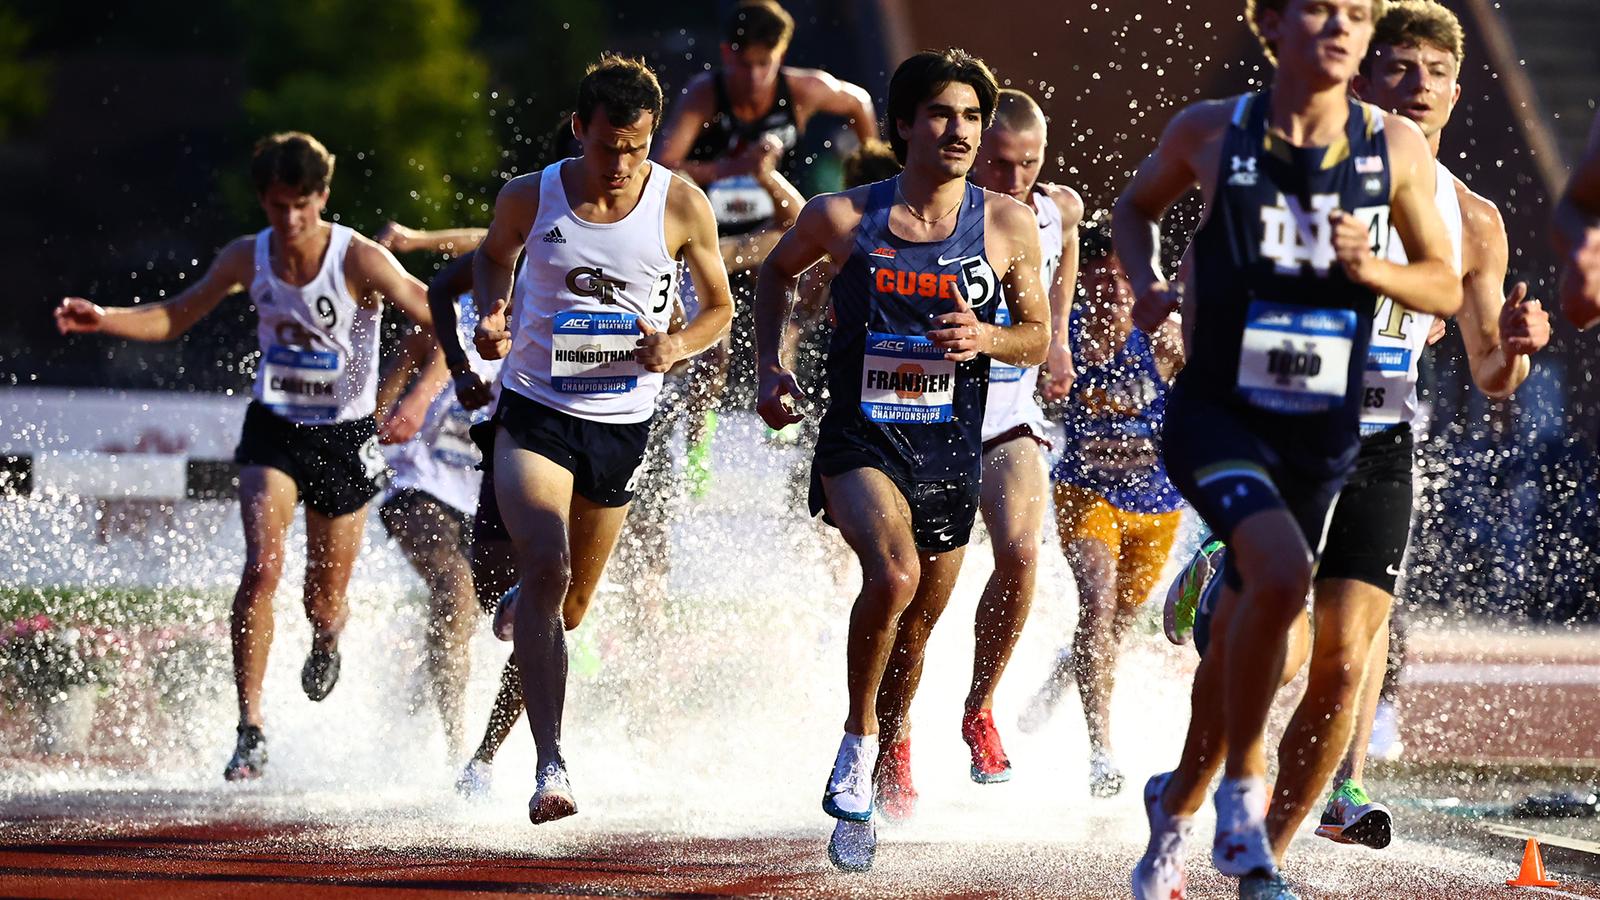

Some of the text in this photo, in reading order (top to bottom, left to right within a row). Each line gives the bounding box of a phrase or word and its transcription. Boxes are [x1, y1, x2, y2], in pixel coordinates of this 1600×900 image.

[543, 236, 566, 244] adidas
[869, 247, 897, 259] ACC
[962, 259, 989, 306] 5
[653, 273, 671, 313] 3
[316, 296, 337, 328] 9
[560, 318, 591, 329] ACC
[872, 340, 905, 352] ACC
[555, 349, 636, 363] HIGINBOTHAM
[561, 382, 627, 392] CHAMPIONSHIPS
[871, 409, 941, 421] CHAMPIONSHIPS
